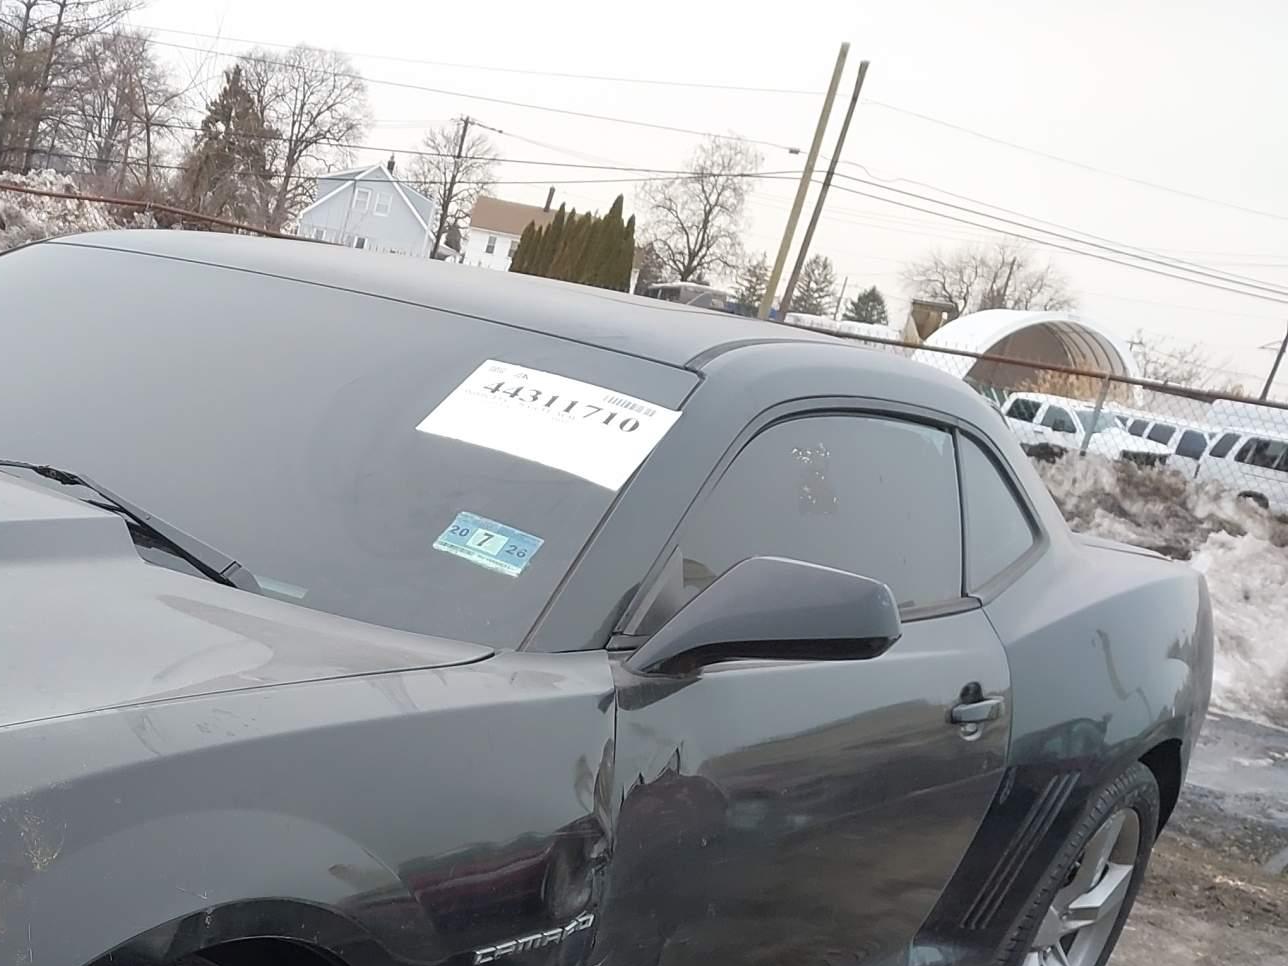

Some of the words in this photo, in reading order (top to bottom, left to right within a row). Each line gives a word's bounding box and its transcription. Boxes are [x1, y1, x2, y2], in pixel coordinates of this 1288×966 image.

[483, 381, 640, 433] 44311710
[449, 524, 470, 538] 20
[476, 532, 495, 547] 7
[504, 544, 528, 559] 26
